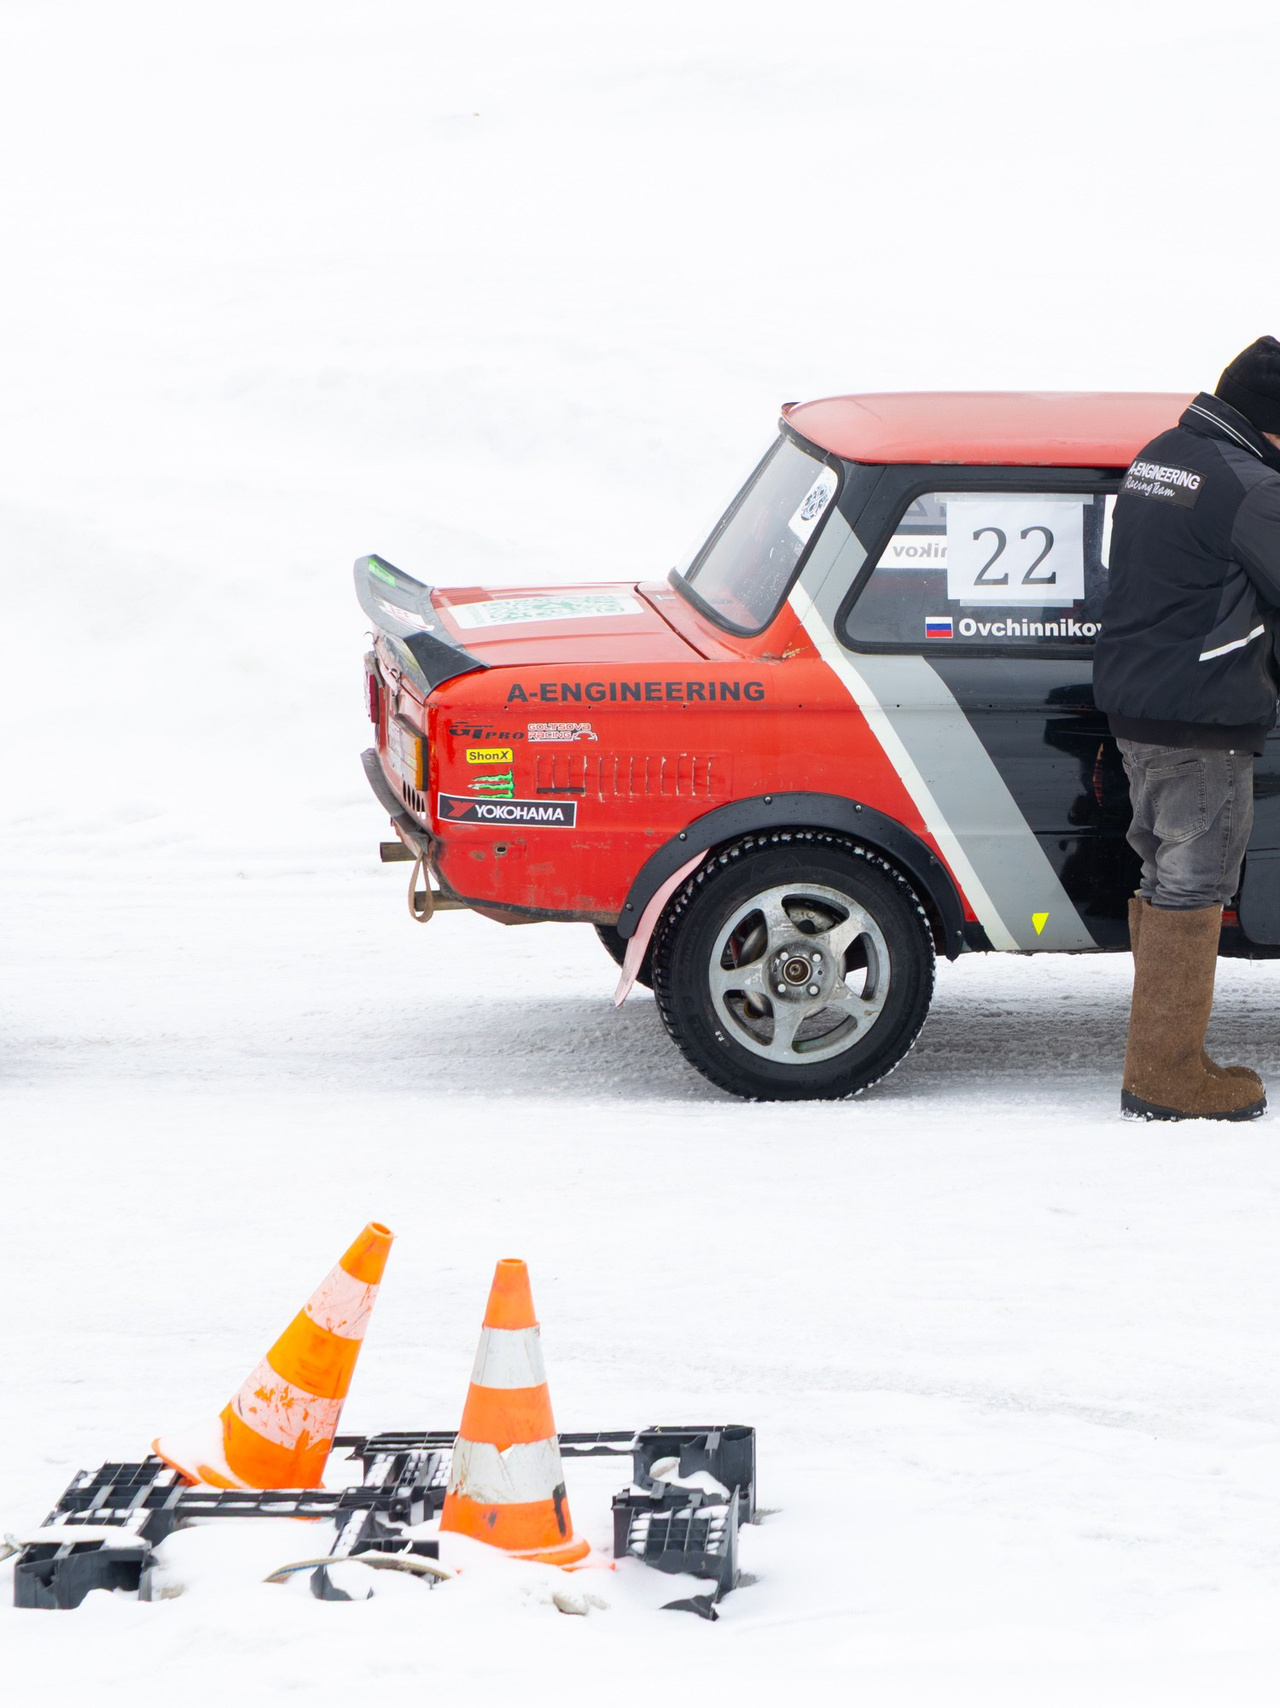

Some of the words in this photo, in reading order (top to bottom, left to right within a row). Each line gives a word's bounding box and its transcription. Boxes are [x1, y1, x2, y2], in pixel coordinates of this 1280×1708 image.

[1127, 461, 1201, 490] A-ENGINEERING
[1125, 476, 1152, 496] Racing
[1152, 481, 1176, 497] Team
[973, 526, 1057, 586] 22
[506, 681, 766, 703] A-ENGINEERING
[448, 721, 495, 740] GT
[485, 732, 525, 740] PRO
[469, 750, 509, 761] ShonX
[474, 804, 565, 821] YOKOHAMA
